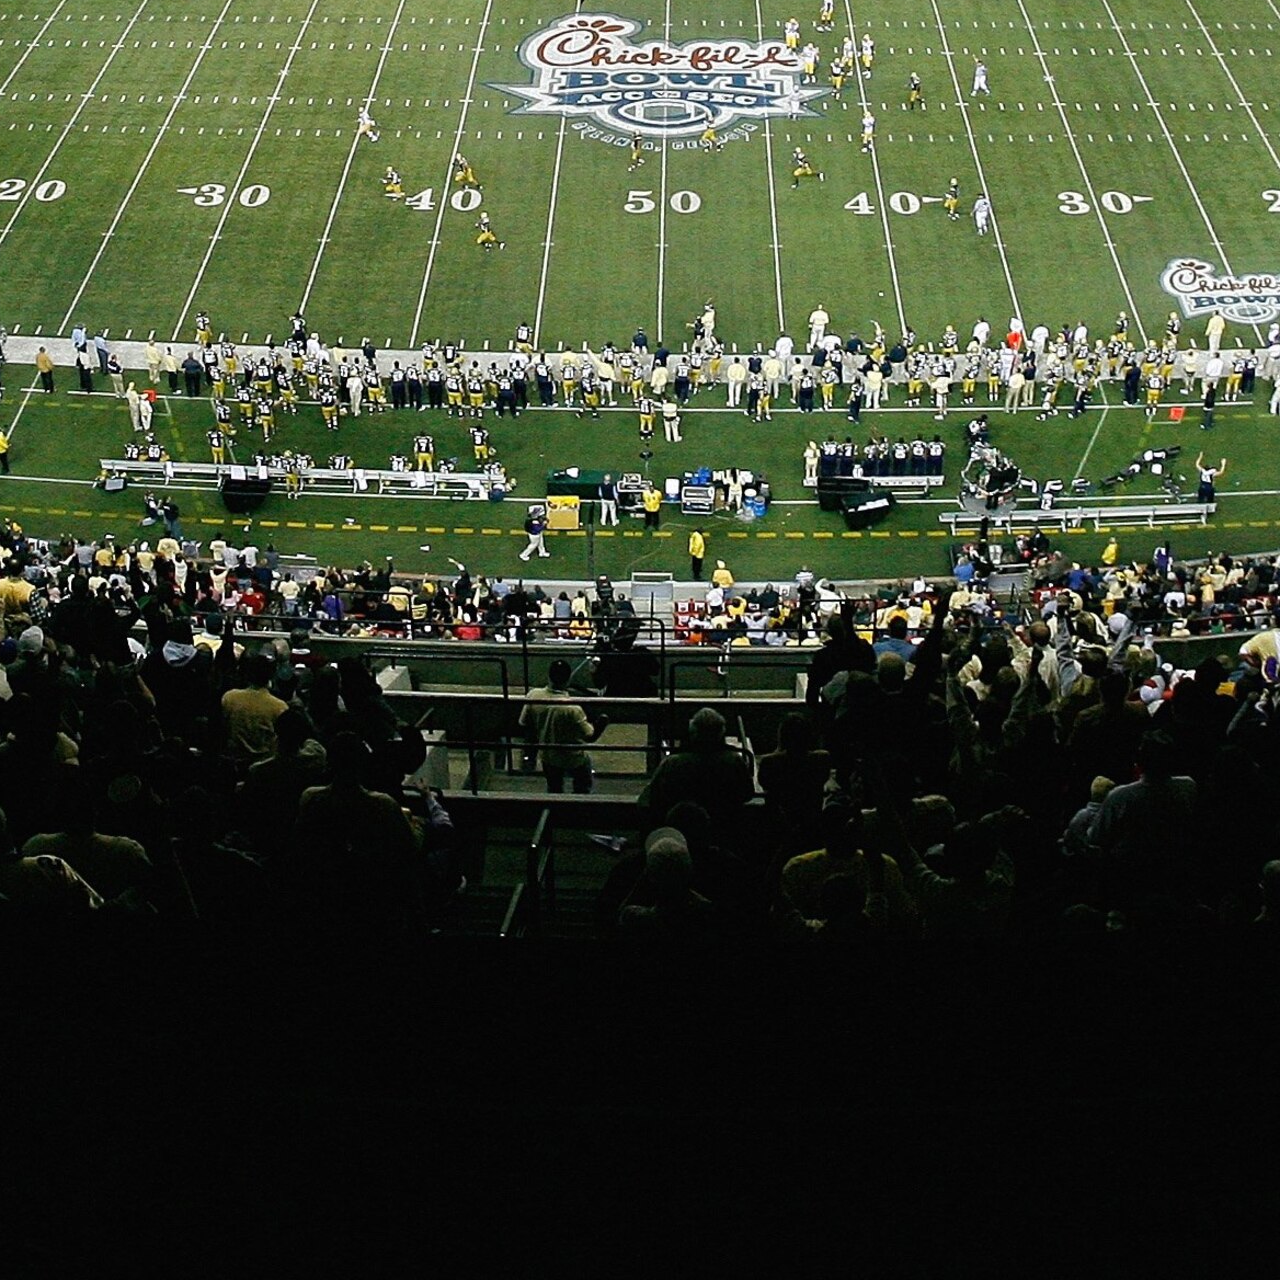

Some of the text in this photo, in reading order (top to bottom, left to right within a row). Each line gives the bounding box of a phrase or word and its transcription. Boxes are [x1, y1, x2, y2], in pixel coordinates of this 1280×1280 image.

[536, 20, 799, 71] Chick-fil-A
[559, 71, 766, 90] BOWL
[576, 91, 647, 105] ACC
[686, 91, 758, 106] SEC
[193, 183, 271, 208] 30
[406, 188, 483, 211] 40
[624, 190, 702, 214] 50
[844, 191, 921, 215] 40
[1058, 190, 1134, 214] 30
